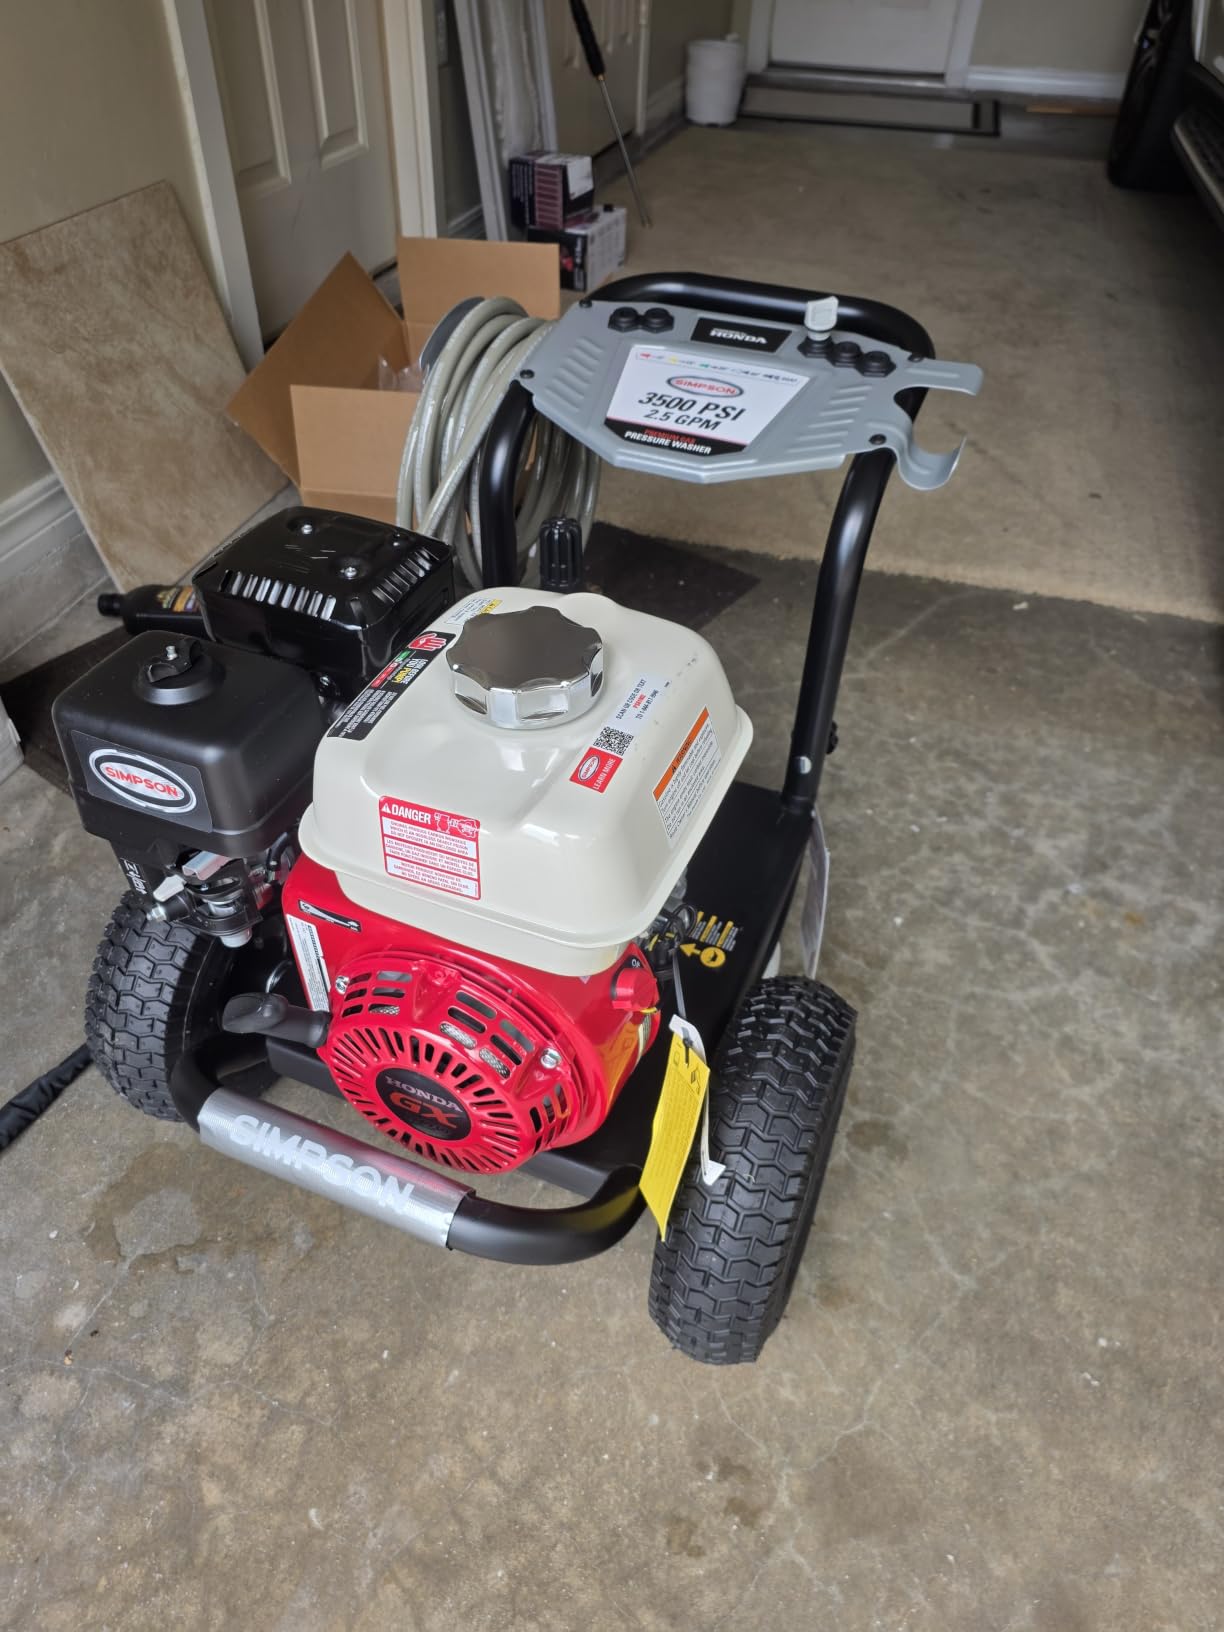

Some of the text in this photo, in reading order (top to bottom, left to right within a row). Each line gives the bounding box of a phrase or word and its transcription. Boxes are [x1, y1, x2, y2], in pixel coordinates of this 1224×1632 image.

[709, 329, 768, 345] HONDA
[674, 378, 737, 395] SIMPSON
[638, 392, 746, 421] 3500 PSI
[643, 408, 721, 431] 2.5 GPM
[624, 430, 712, 455] PRESSURE WASHER
[644, 428, 680, 441] PREMIUM
[105, 766, 178, 797] SIMPSON
[592, 758, 616, 791] LEARN MORE
[391, 804, 432, 825] DANGER
[385, 1075, 464, 1113] HONDA
[389, 1091, 460, 1129] GX
[229, 1114, 418, 1214] SIMPSON
